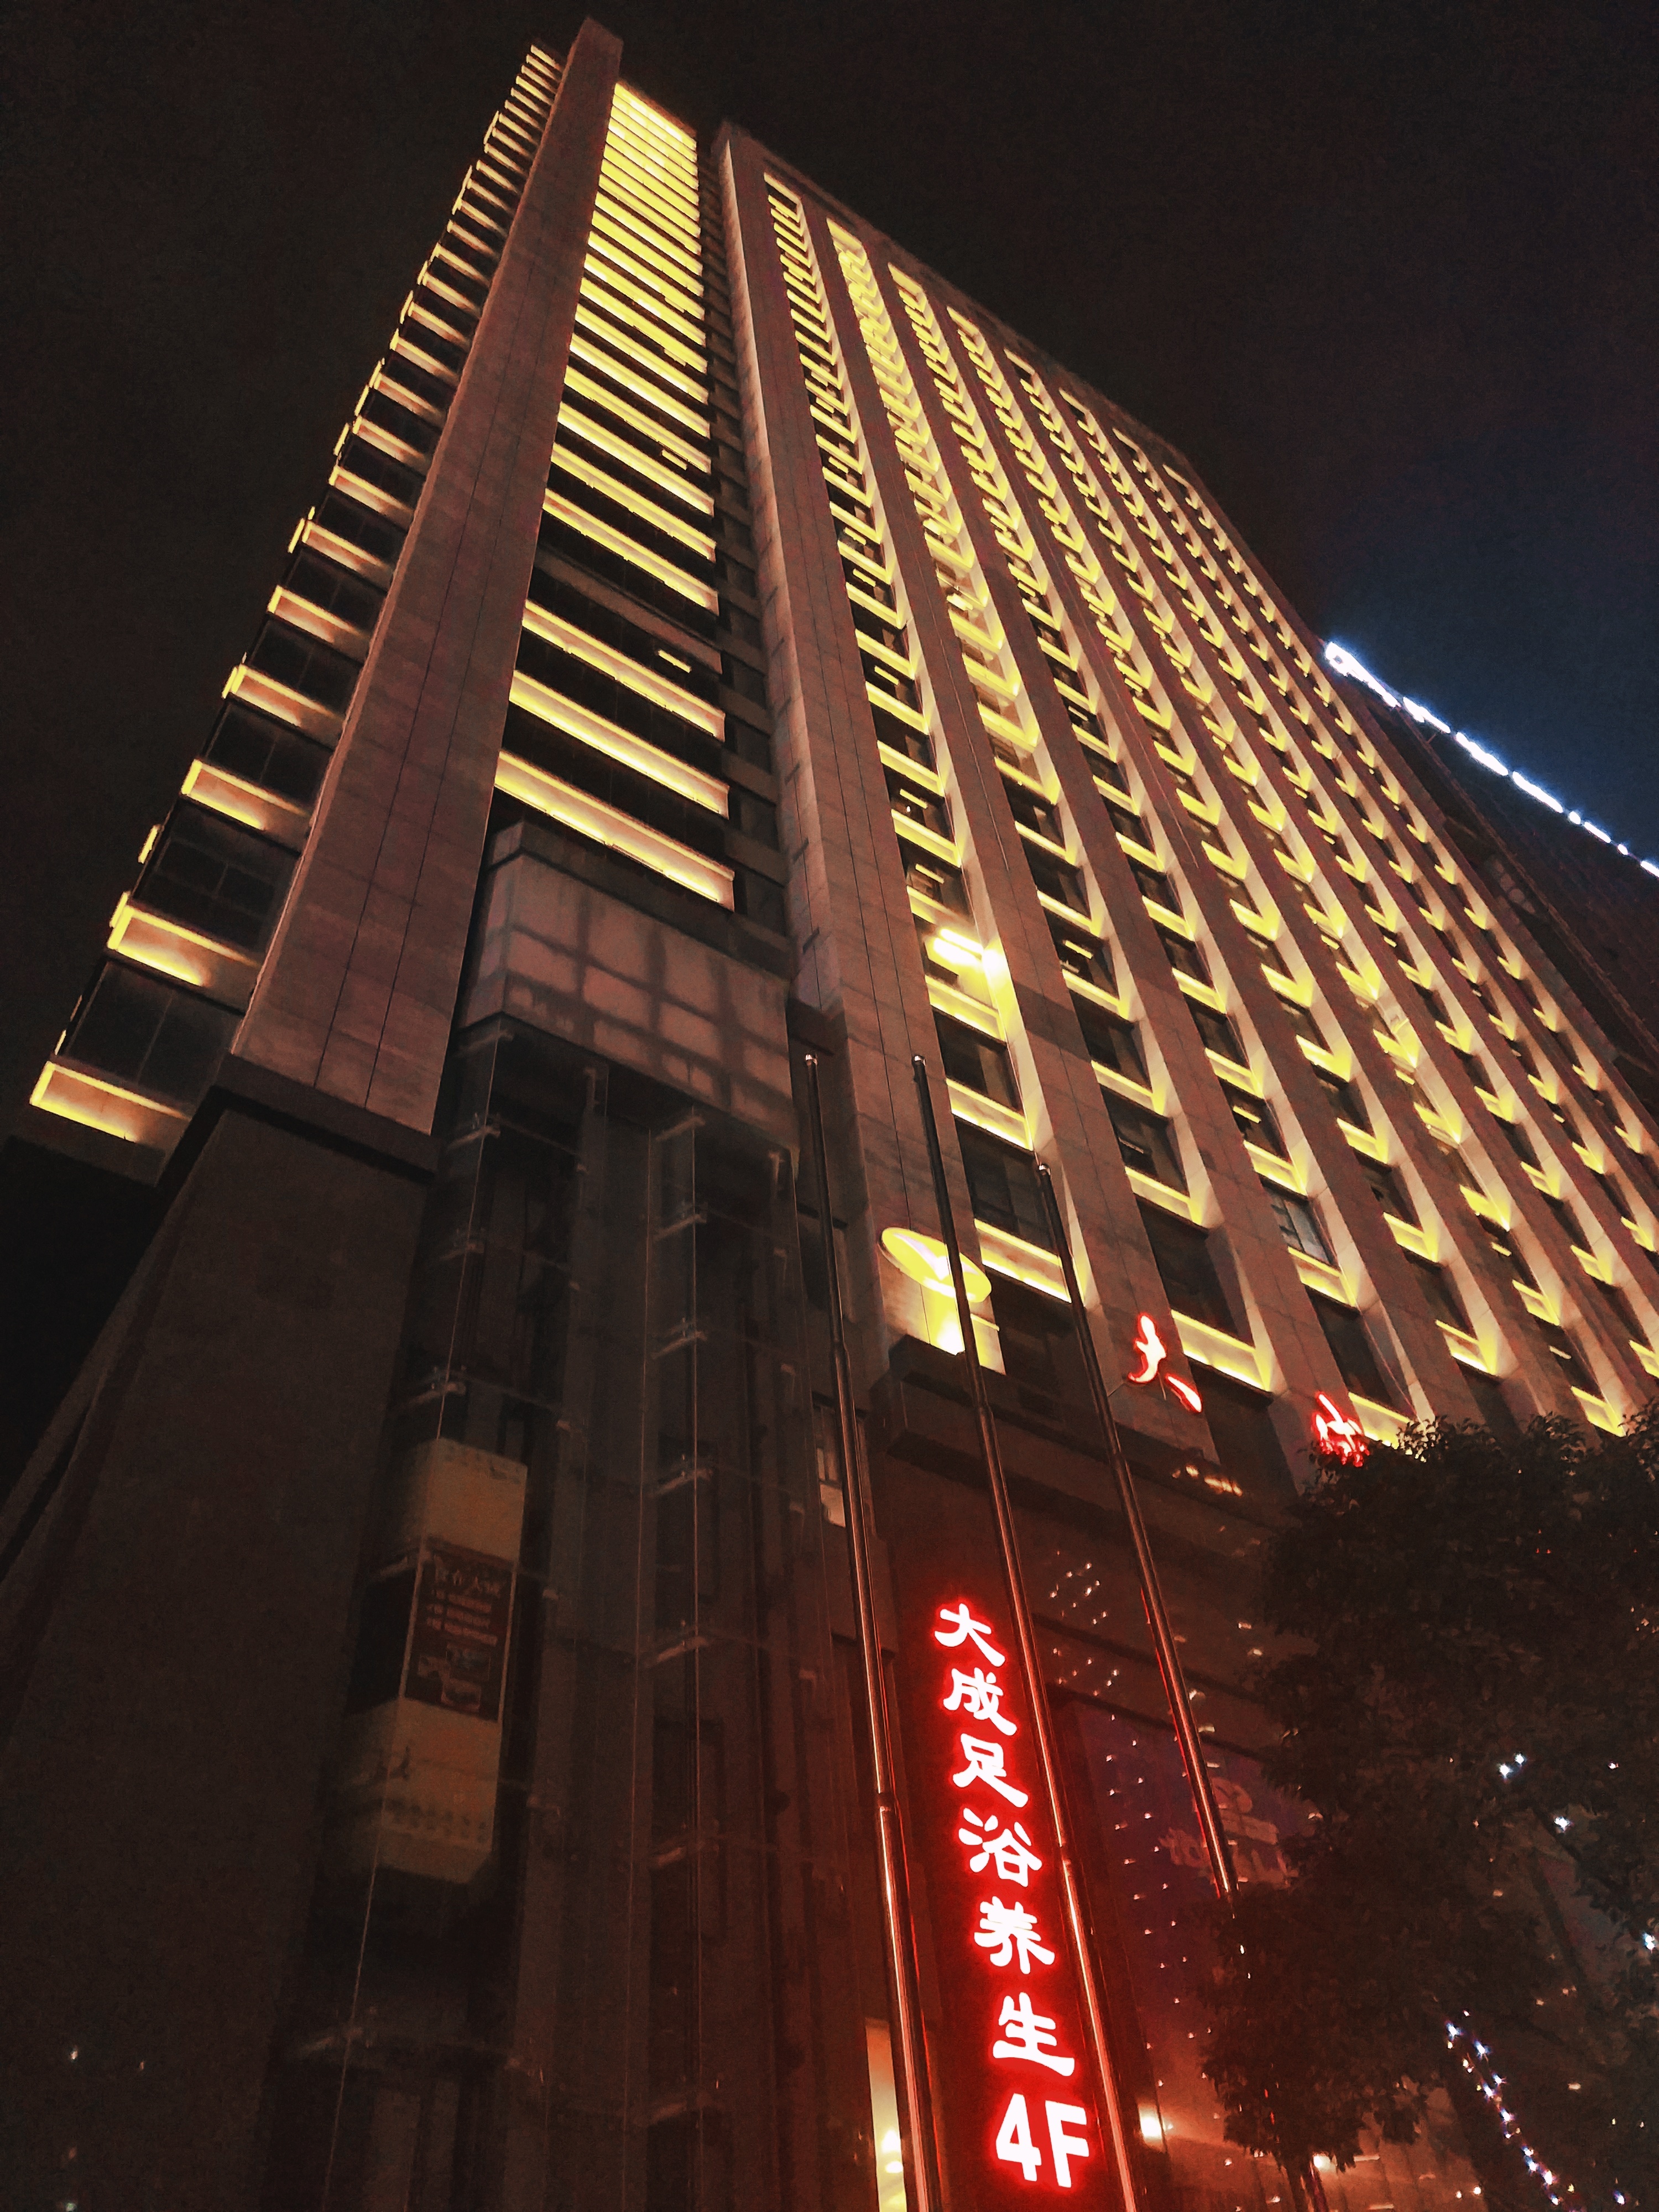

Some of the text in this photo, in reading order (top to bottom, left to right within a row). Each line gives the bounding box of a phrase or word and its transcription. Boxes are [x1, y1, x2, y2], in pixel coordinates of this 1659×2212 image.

[934, 1603, 1090, 2188] 大成足浴养生 4F
